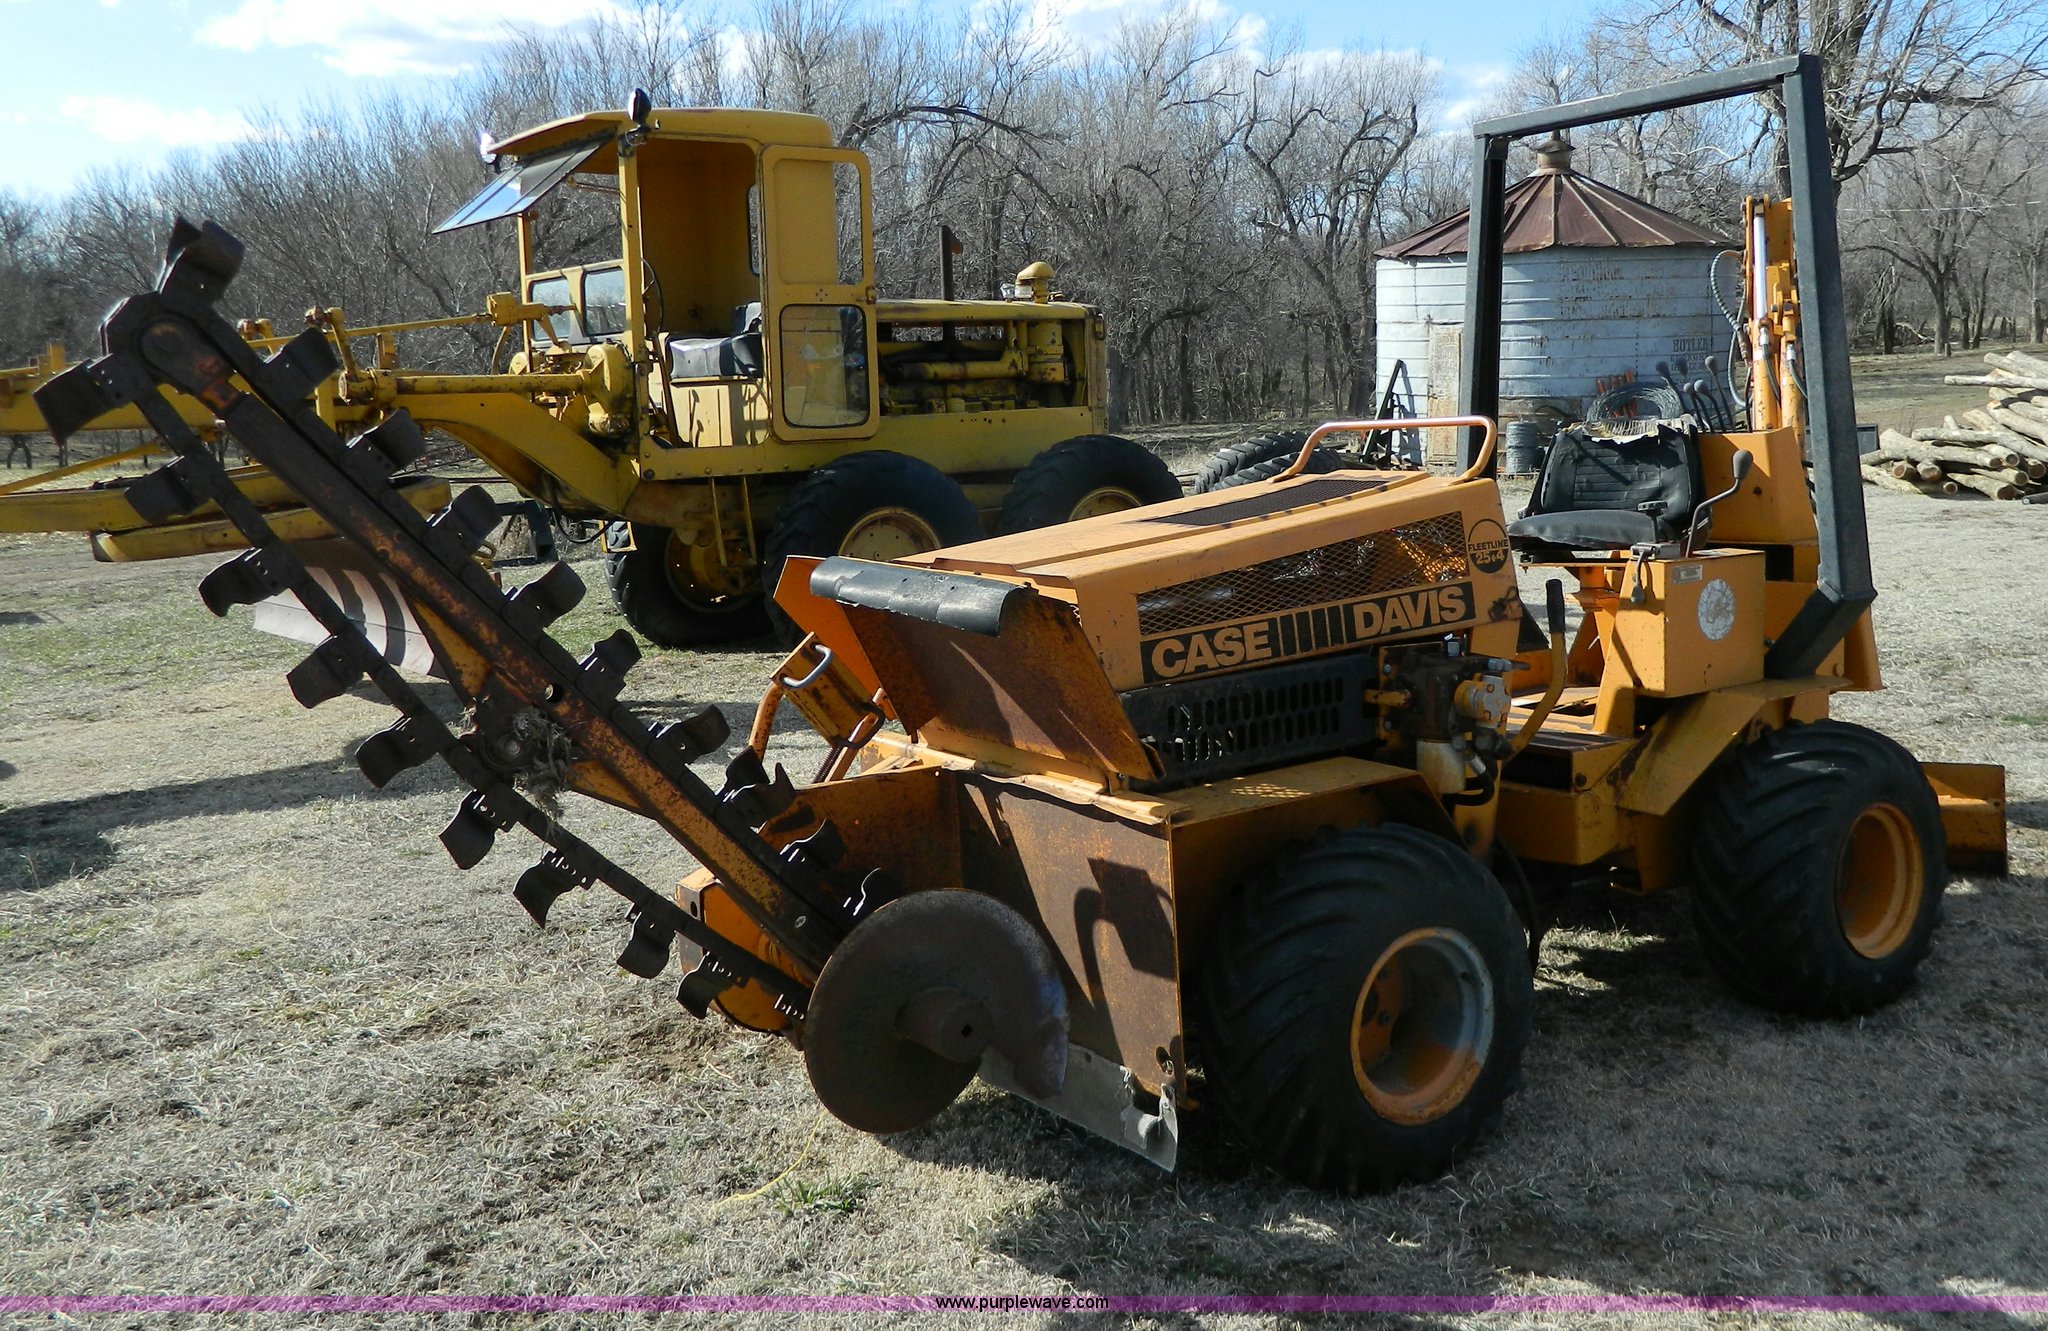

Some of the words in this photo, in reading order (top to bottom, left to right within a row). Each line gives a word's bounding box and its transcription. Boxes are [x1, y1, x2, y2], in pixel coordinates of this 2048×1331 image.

[1673, 337, 1709, 352] BUTLER
[1468, 539, 1508, 551] FLEETLINE
[1151, 621, 1272, 678] CASE
[1353, 586, 1466, 640] DAVIS
